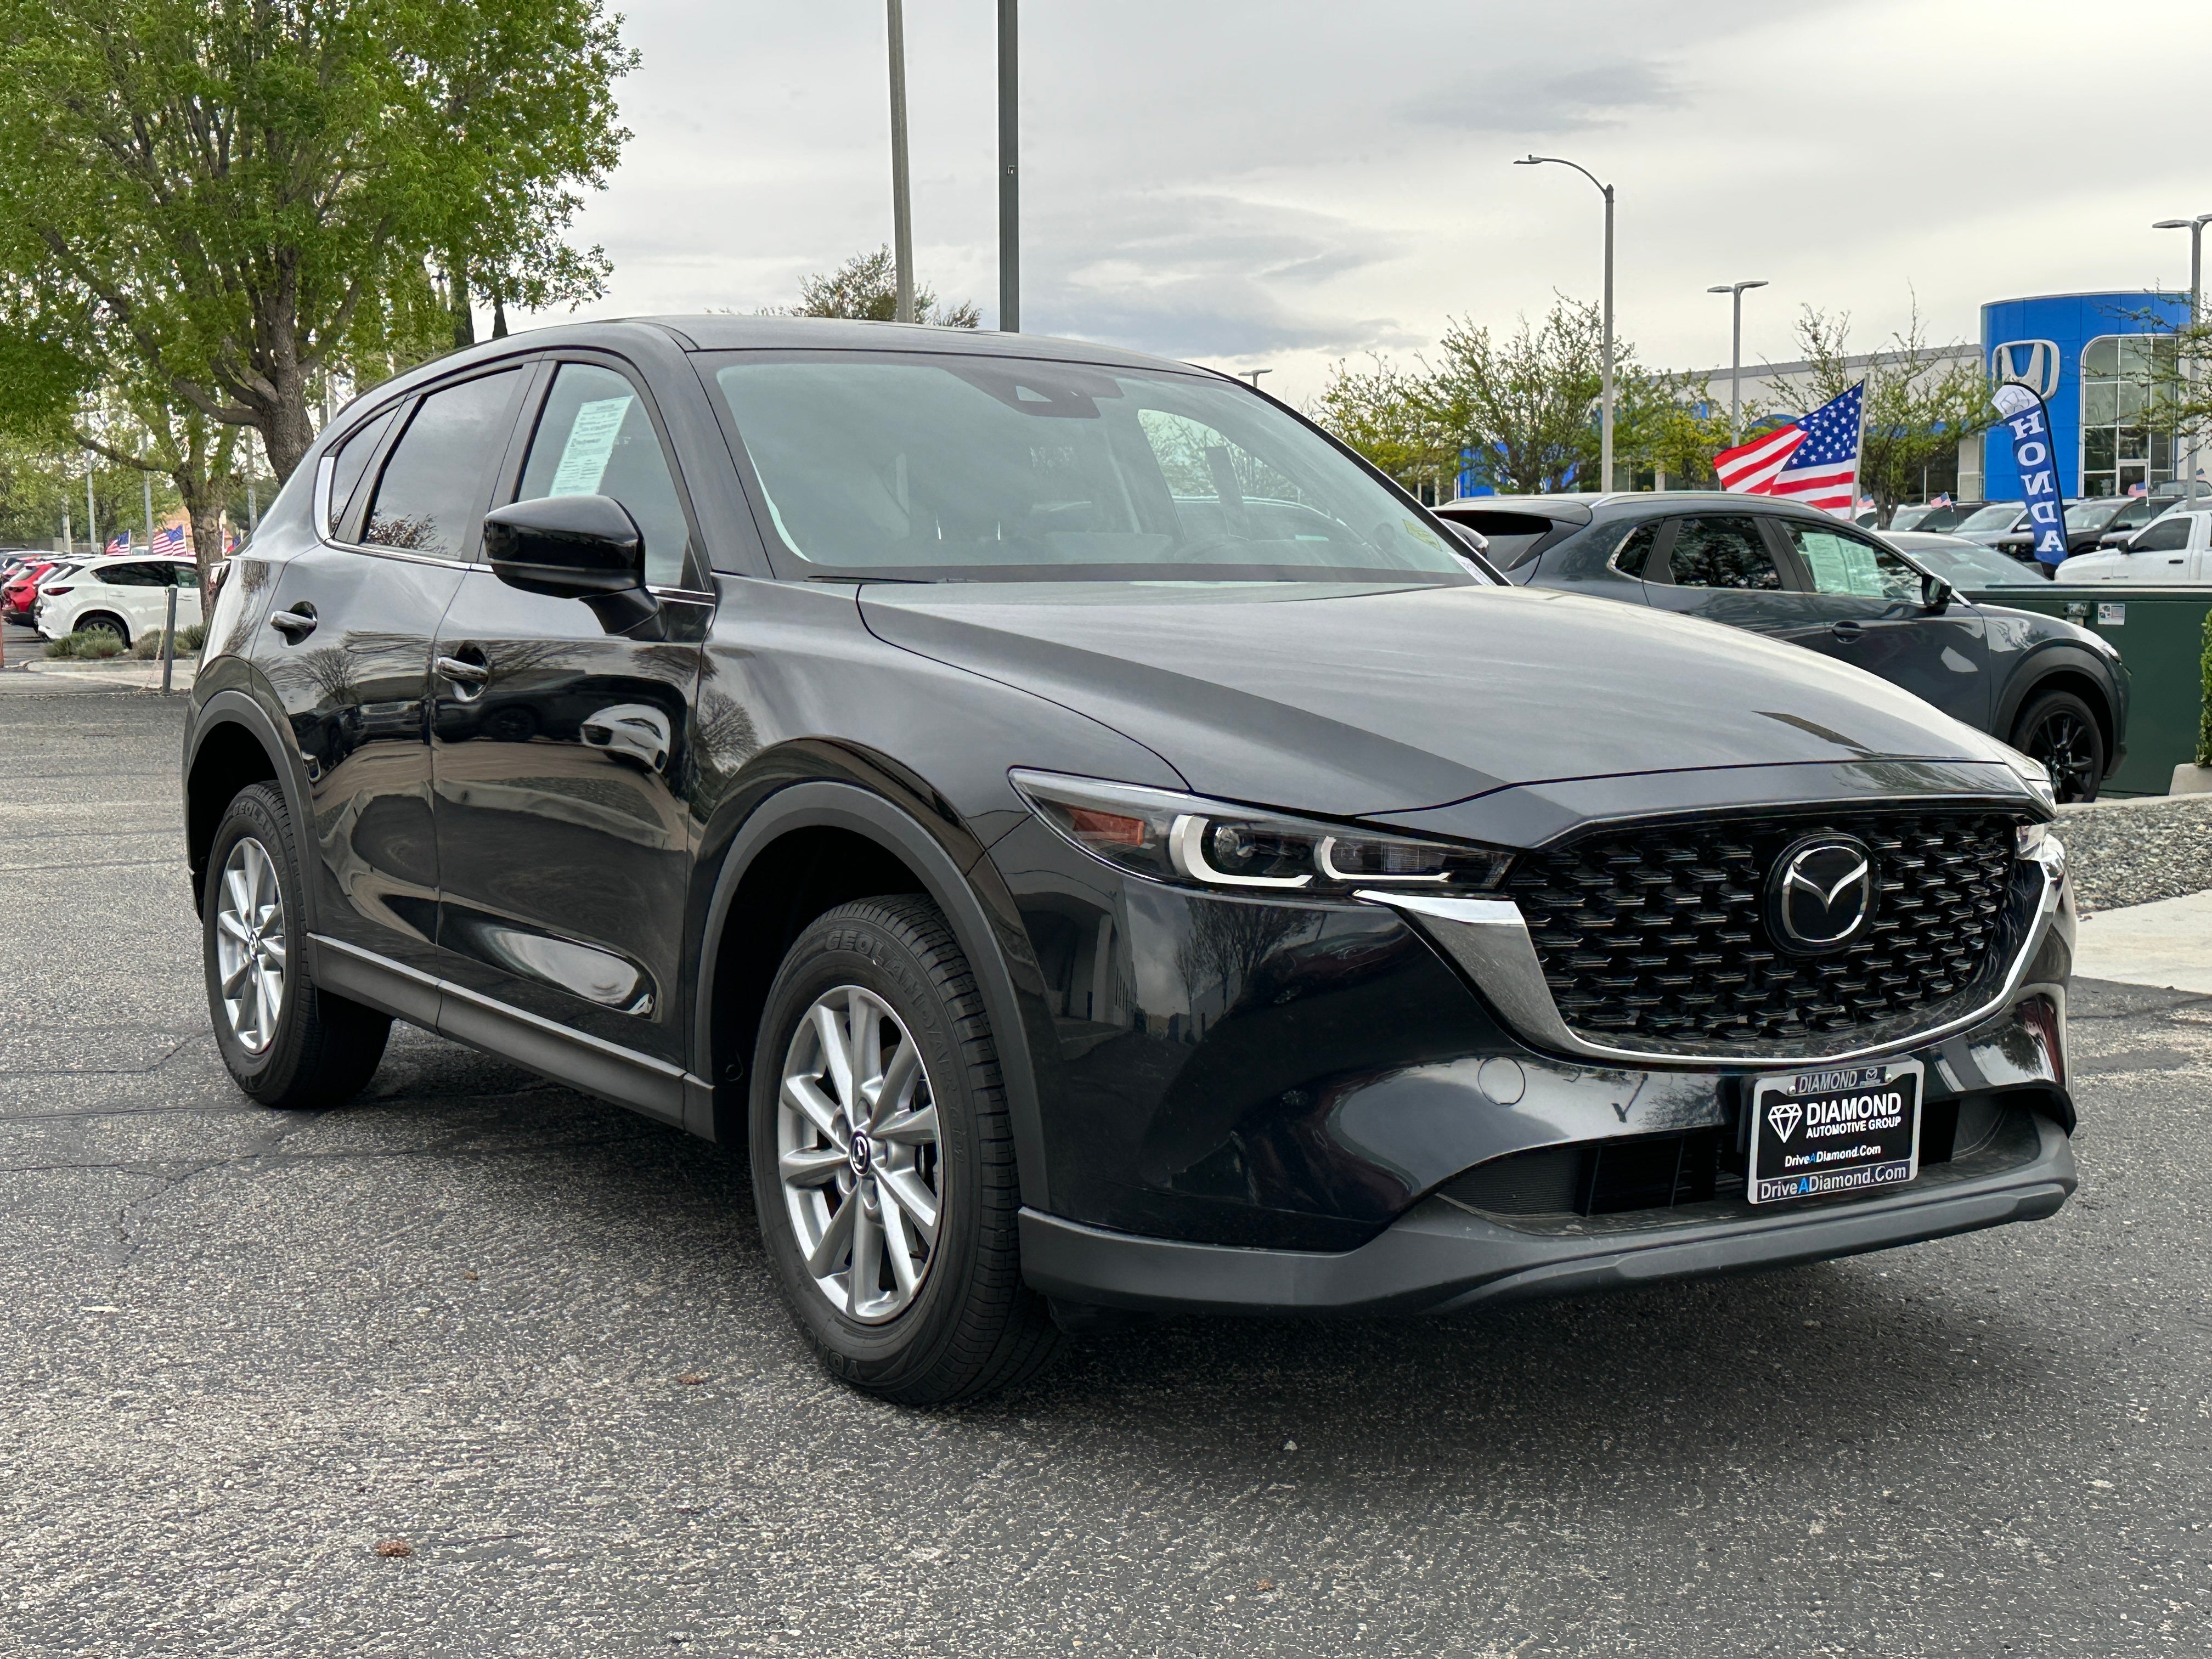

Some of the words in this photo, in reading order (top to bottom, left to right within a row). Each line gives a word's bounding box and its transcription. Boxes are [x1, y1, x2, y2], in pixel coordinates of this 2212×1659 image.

[1798, 1071, 1858, 1093] DIAMOND
[1807, 1092, 1902, 1126] DIAMOND
[1806, 1121, 1866, 1139] AUTOMOTIVE
[1868, 1116, 1901, 1131] GROUP
[1785, 1145, 1881, 1167] DriveADiamond.Com
[1760, 1166, 1906, 1200] DriveADiamond.Com
